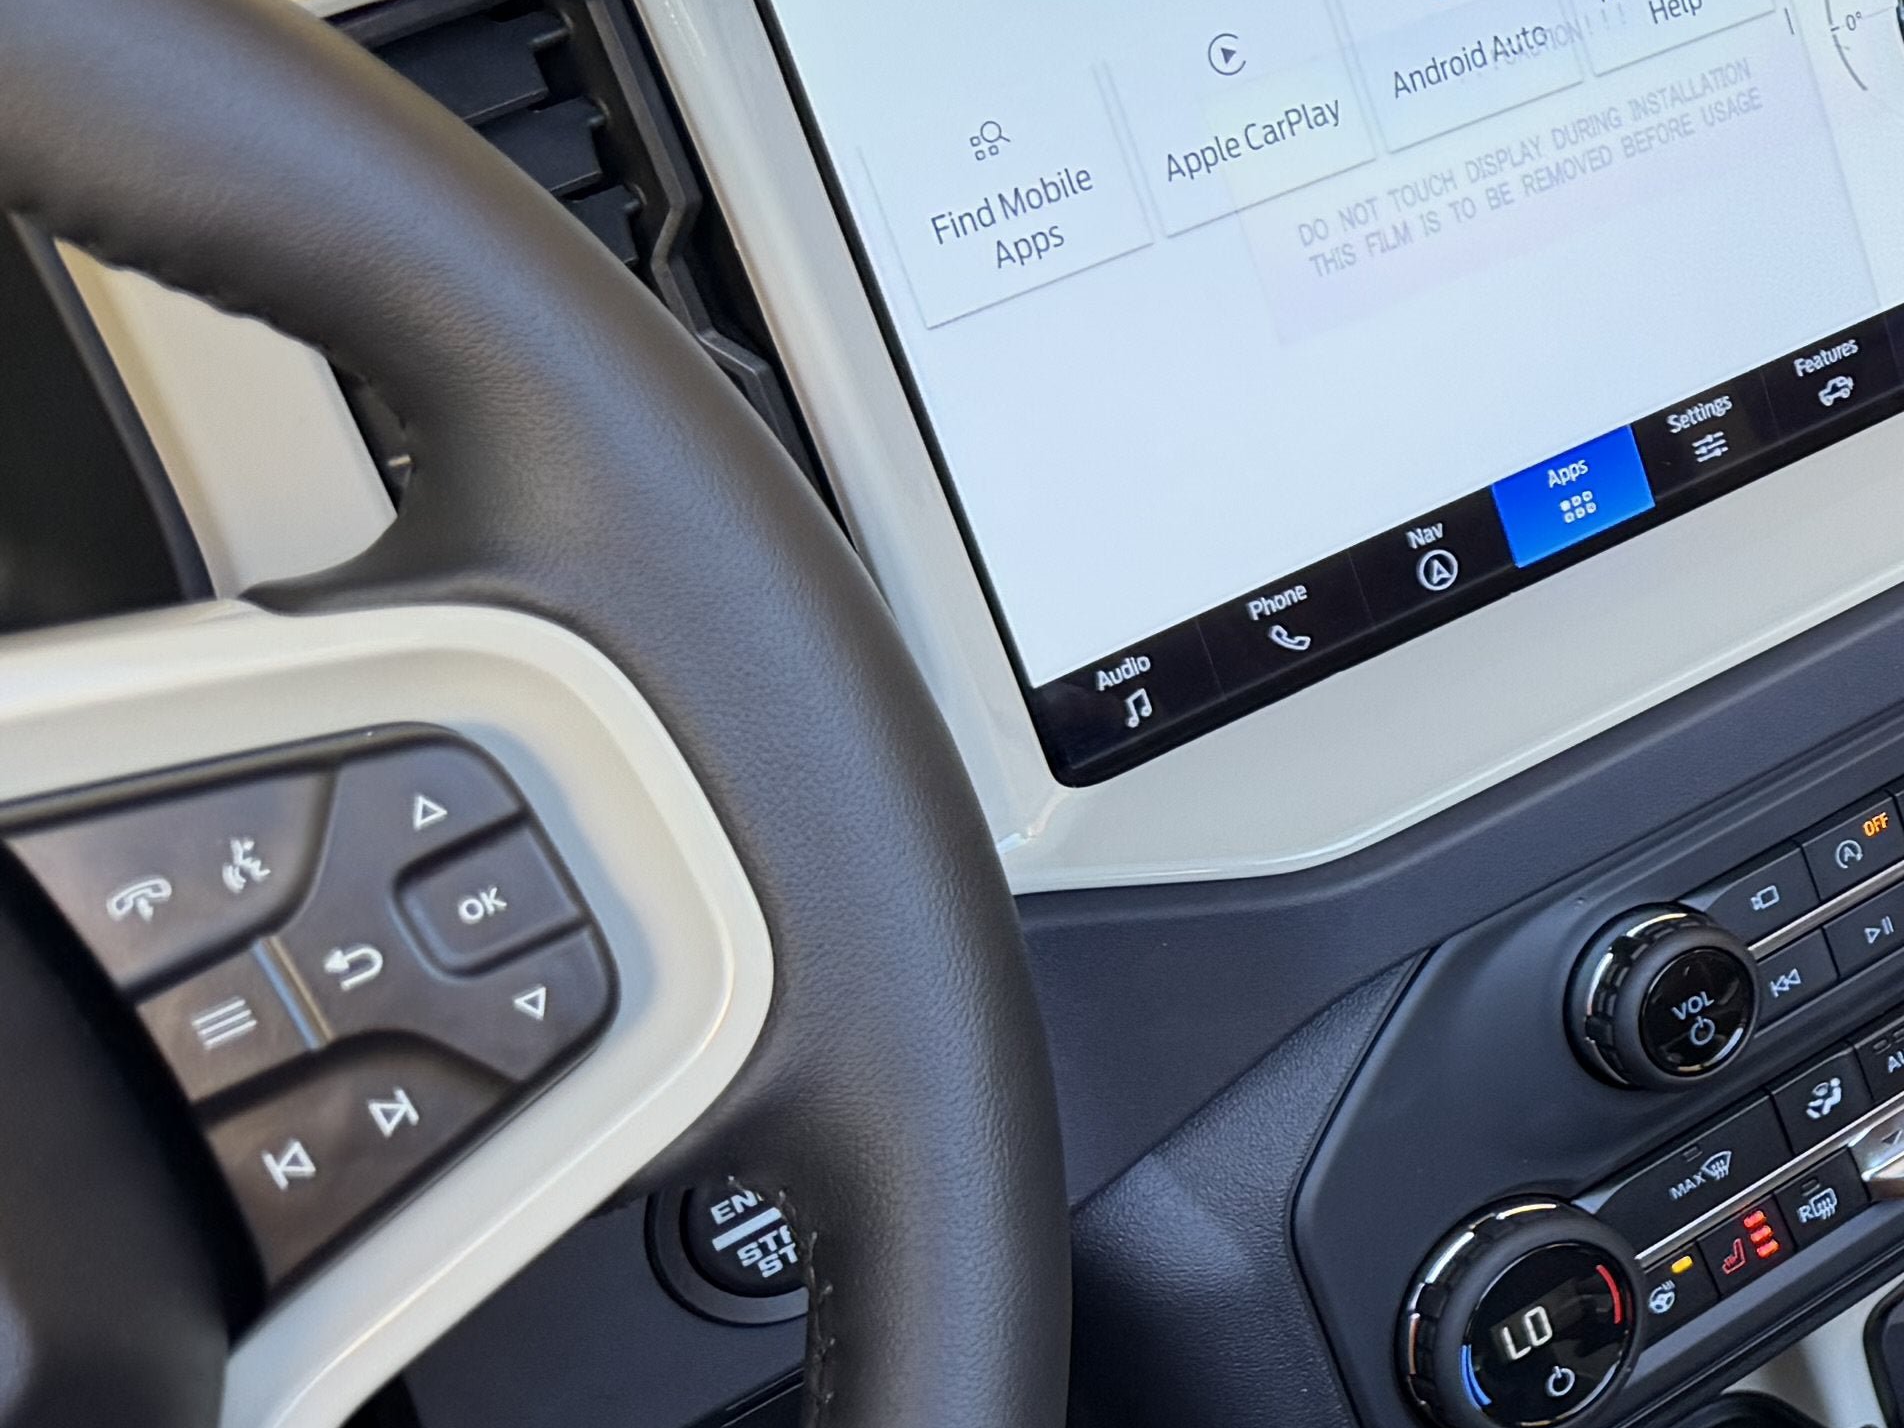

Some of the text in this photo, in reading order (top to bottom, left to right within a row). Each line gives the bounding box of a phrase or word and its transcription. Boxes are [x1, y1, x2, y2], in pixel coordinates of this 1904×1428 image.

[1393, 23, 1548, 98] Android Auto
[1165, 98, 1342, 182] Apple CarPlay
[1298, 57, 1752, 248] DO NOT TOUCH DISPLAY DURING INSTALLATION
[1309, 86, 1764, 279] THIS FILM IS TO BE REMOVED BEFORE USAGE
[930, 166, 1094, 246] Find Mobile
[994, 223, 1066, 268] Apps
[1794, 336, 1859, 377] Features
[1667, 392, 1733, 435] Settings
[1547, 456, 1589, 489] Apps
[1407, 520, 1444, 550] Nav
[1247, 581, 1309, 621] Phone
[1095, 651, 1151, 692] Audio
[1862, 812, 1890, 837] OFF
[457, 885, 508, 925] OK
[1672, 990, 1715, 1021] VOL
[709, 1189, 765, 1225] EN
[1670, 1172, 1706, 1201] MAX
[1501, 1305, 1553, 1362] LO
